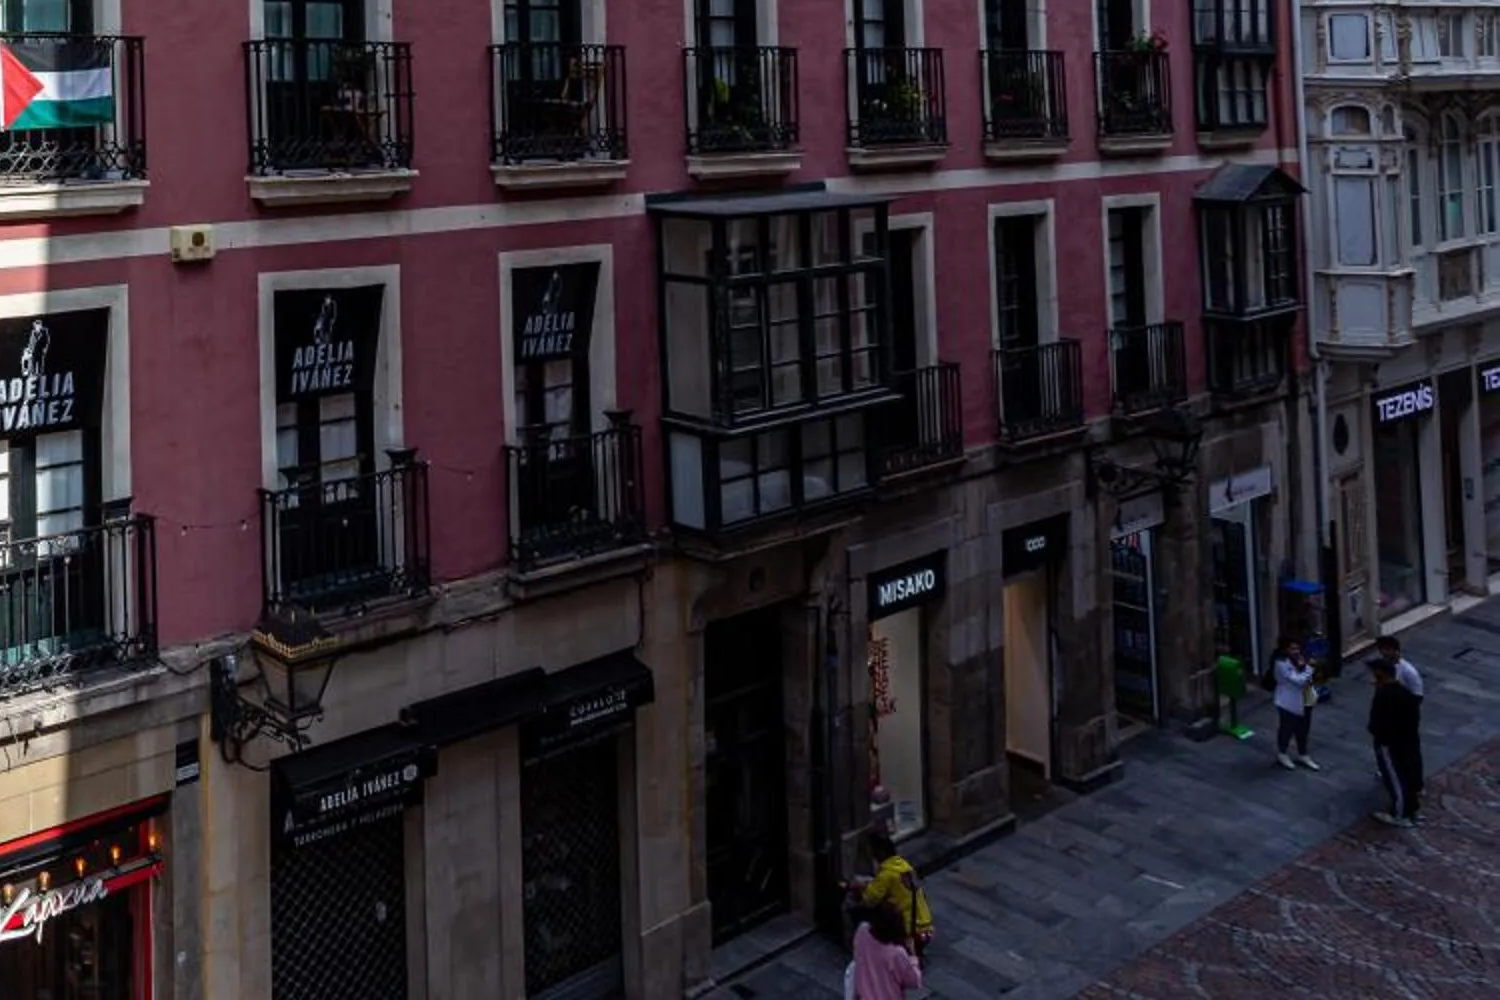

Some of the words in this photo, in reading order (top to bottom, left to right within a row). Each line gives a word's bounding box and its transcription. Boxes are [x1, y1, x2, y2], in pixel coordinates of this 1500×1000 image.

[523, 311, 576, 337] ADELIA
[292, 339, 354, 371] ADELIA
[1376, 383, 1433, 423] TEZENIS
[878, 568, 936, 607] MISAKO
